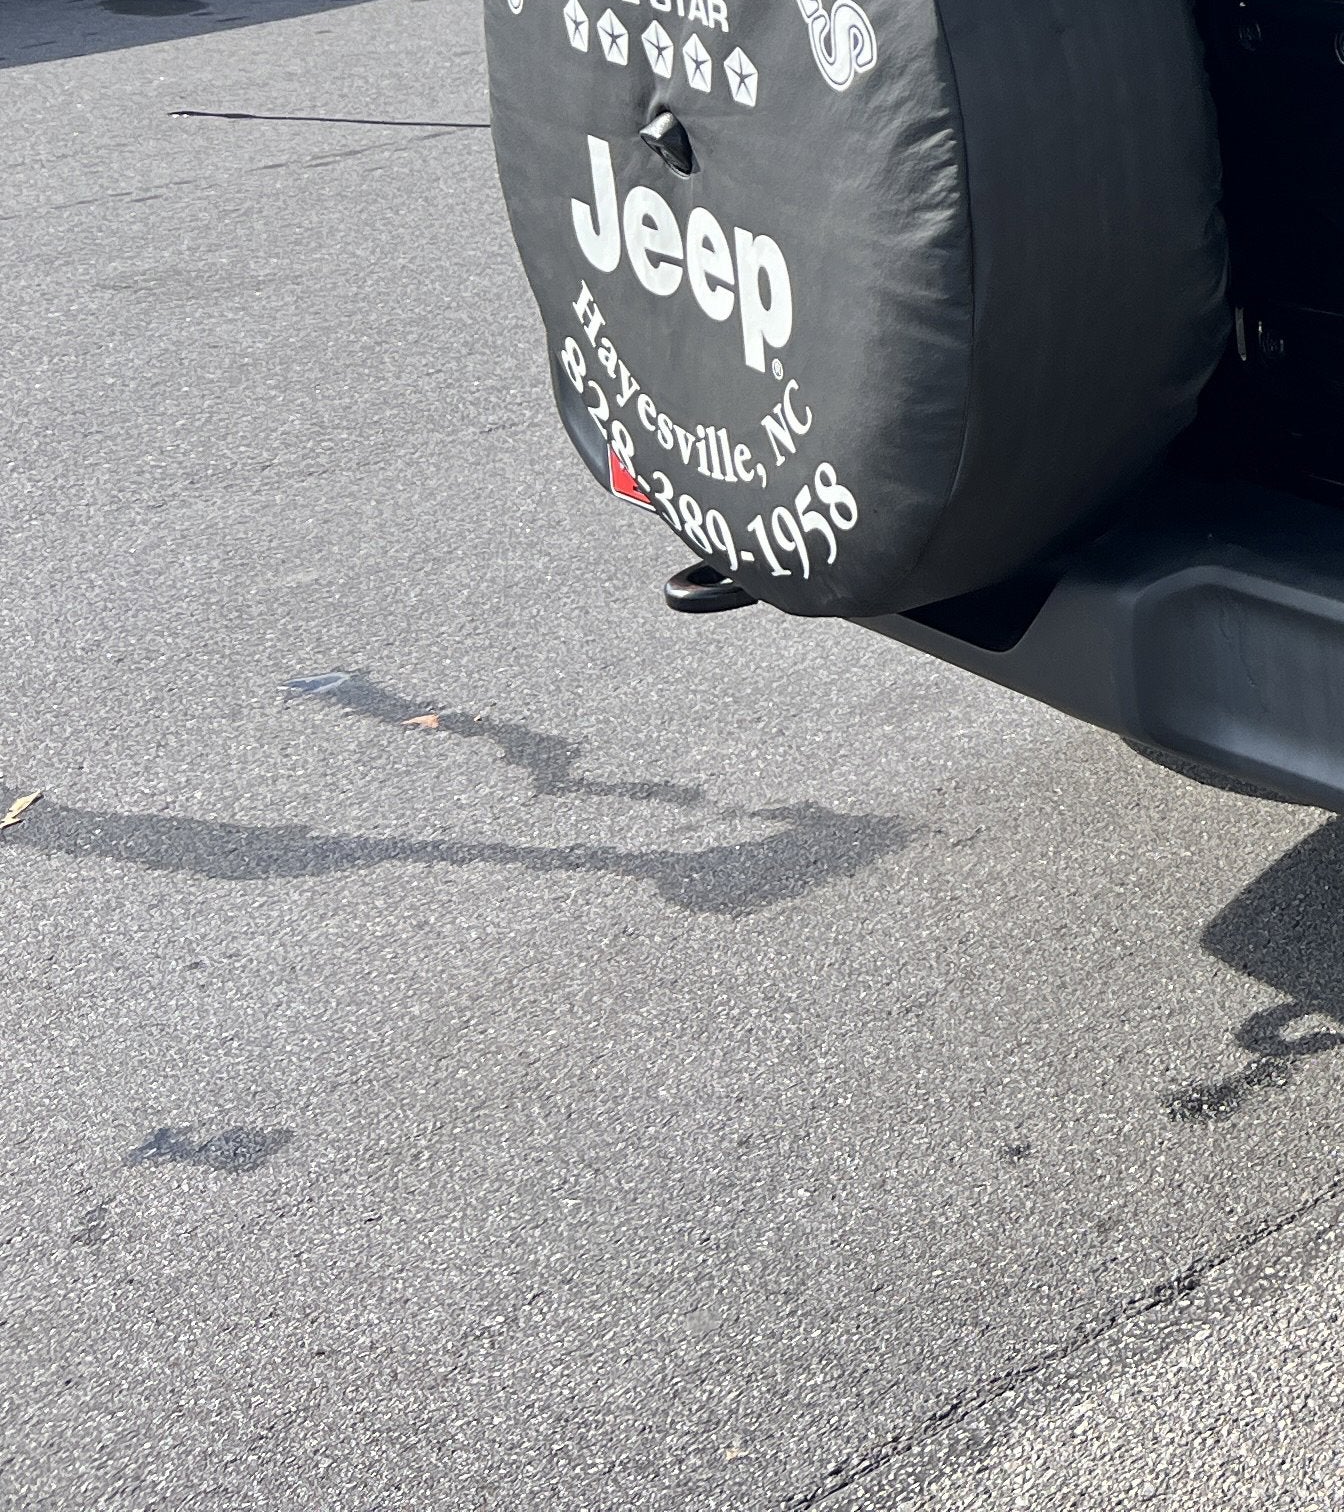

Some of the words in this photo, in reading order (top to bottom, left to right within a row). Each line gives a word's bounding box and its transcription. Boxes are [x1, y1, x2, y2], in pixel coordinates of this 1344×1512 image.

[571, 134, 793, 374] Jeep
[560, 336, 858, 580] 828-389-1958
[572, 279, 767, 489] Hayesville,
[760, 378, 813, 467] NC
